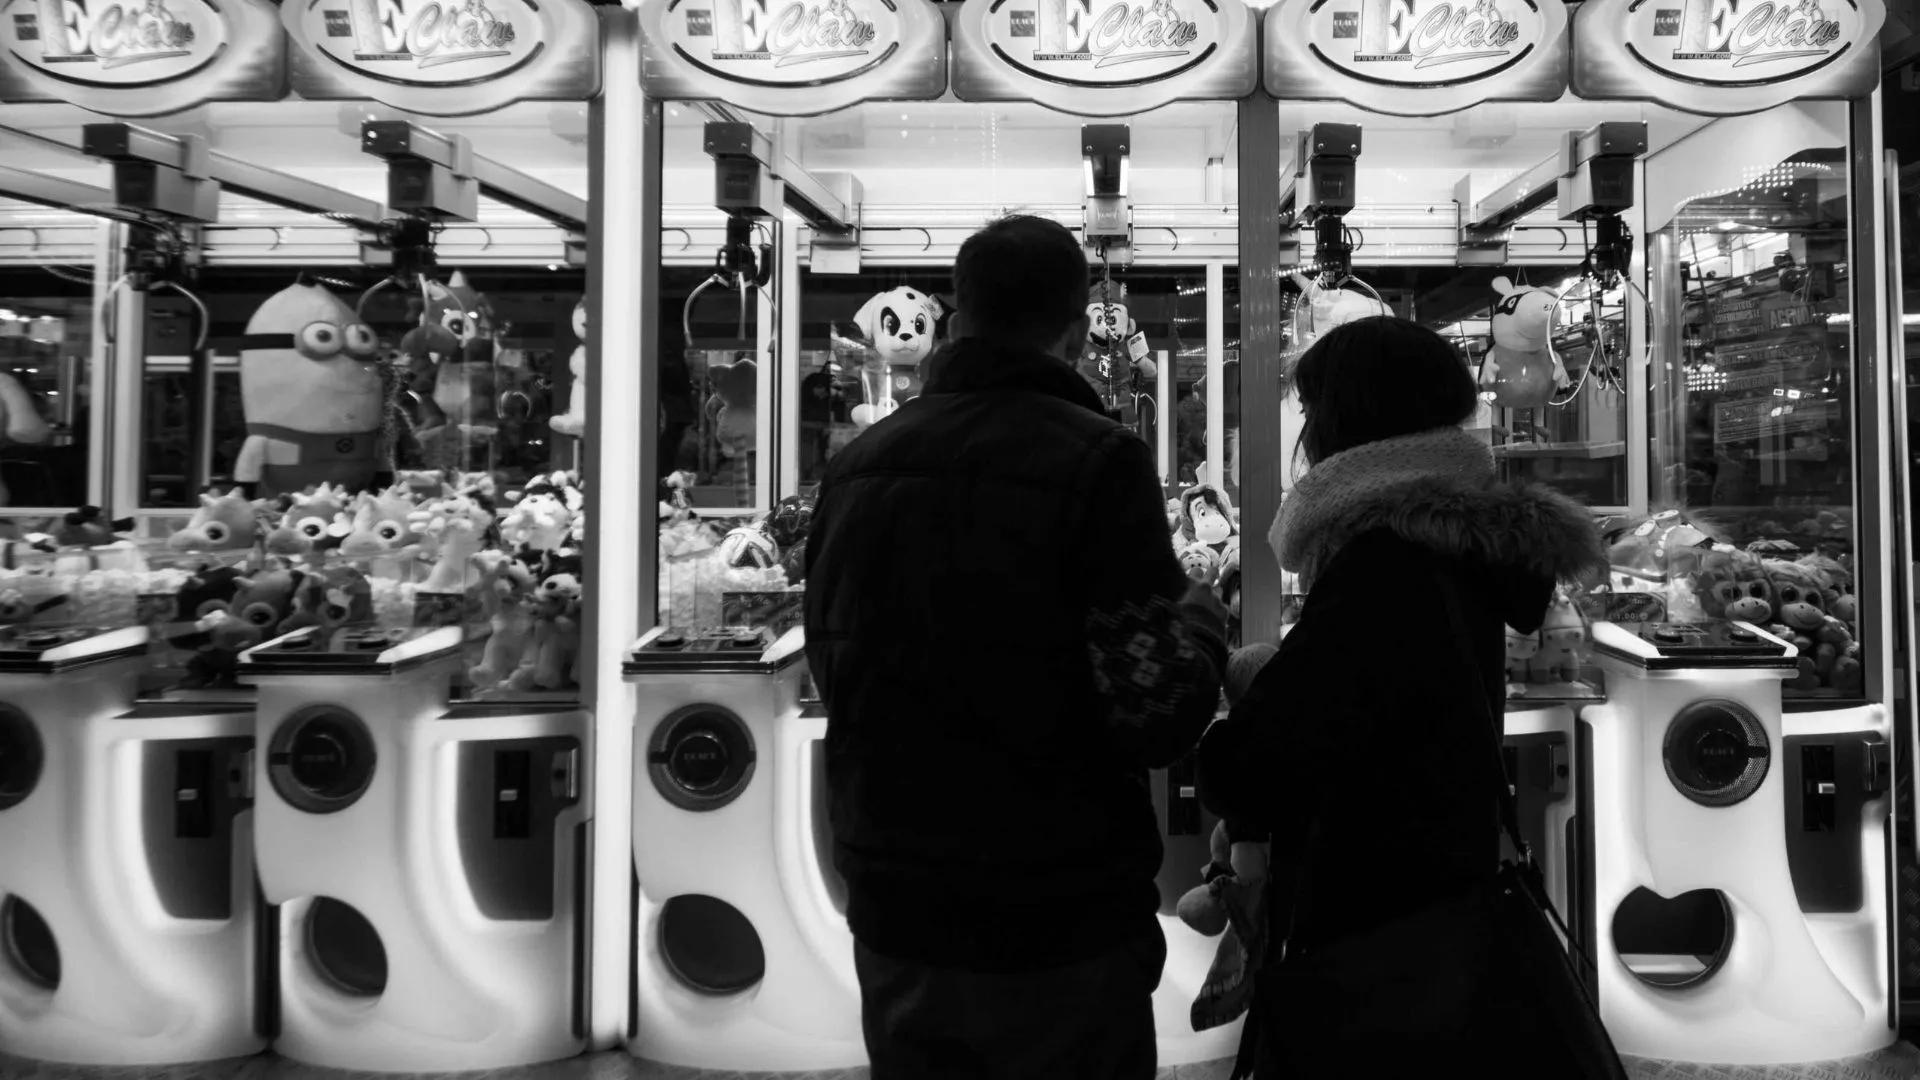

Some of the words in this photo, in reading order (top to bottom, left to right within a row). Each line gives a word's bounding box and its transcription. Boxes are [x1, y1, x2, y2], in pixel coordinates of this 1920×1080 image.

[405, 2, 516, 57] Claw
[766, 2, 875, 56] Claw
[1089, 2, 1198, 57] Claw
[1410, 3, 1518, 57] Claw
[1729, 1, 1840, 55] Claw
